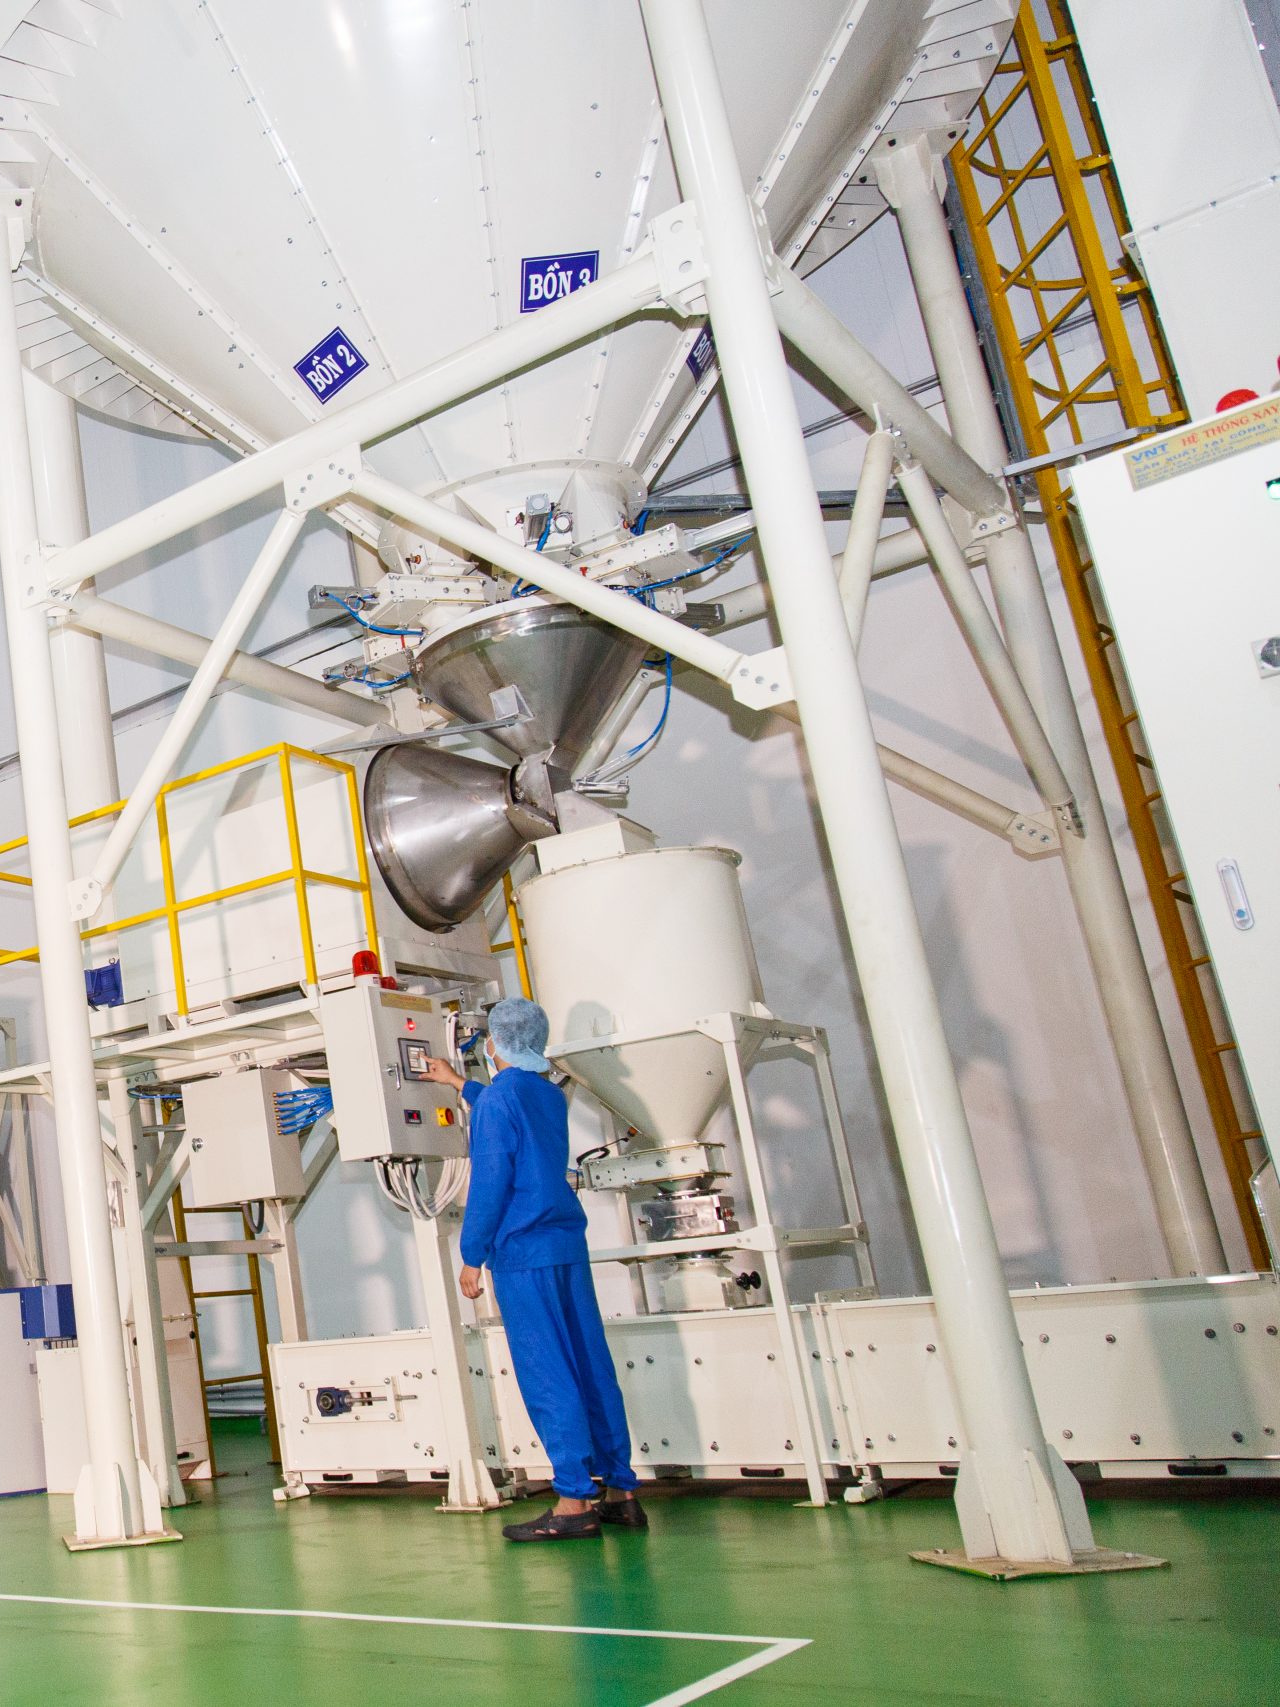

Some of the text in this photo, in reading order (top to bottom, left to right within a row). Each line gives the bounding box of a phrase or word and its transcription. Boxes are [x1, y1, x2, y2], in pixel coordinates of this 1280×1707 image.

[527, 261, 591, 301] BỒN 3
[306, 344, 357, 393] BỒN 2
[1131, 442, 1168, 463] VNT
